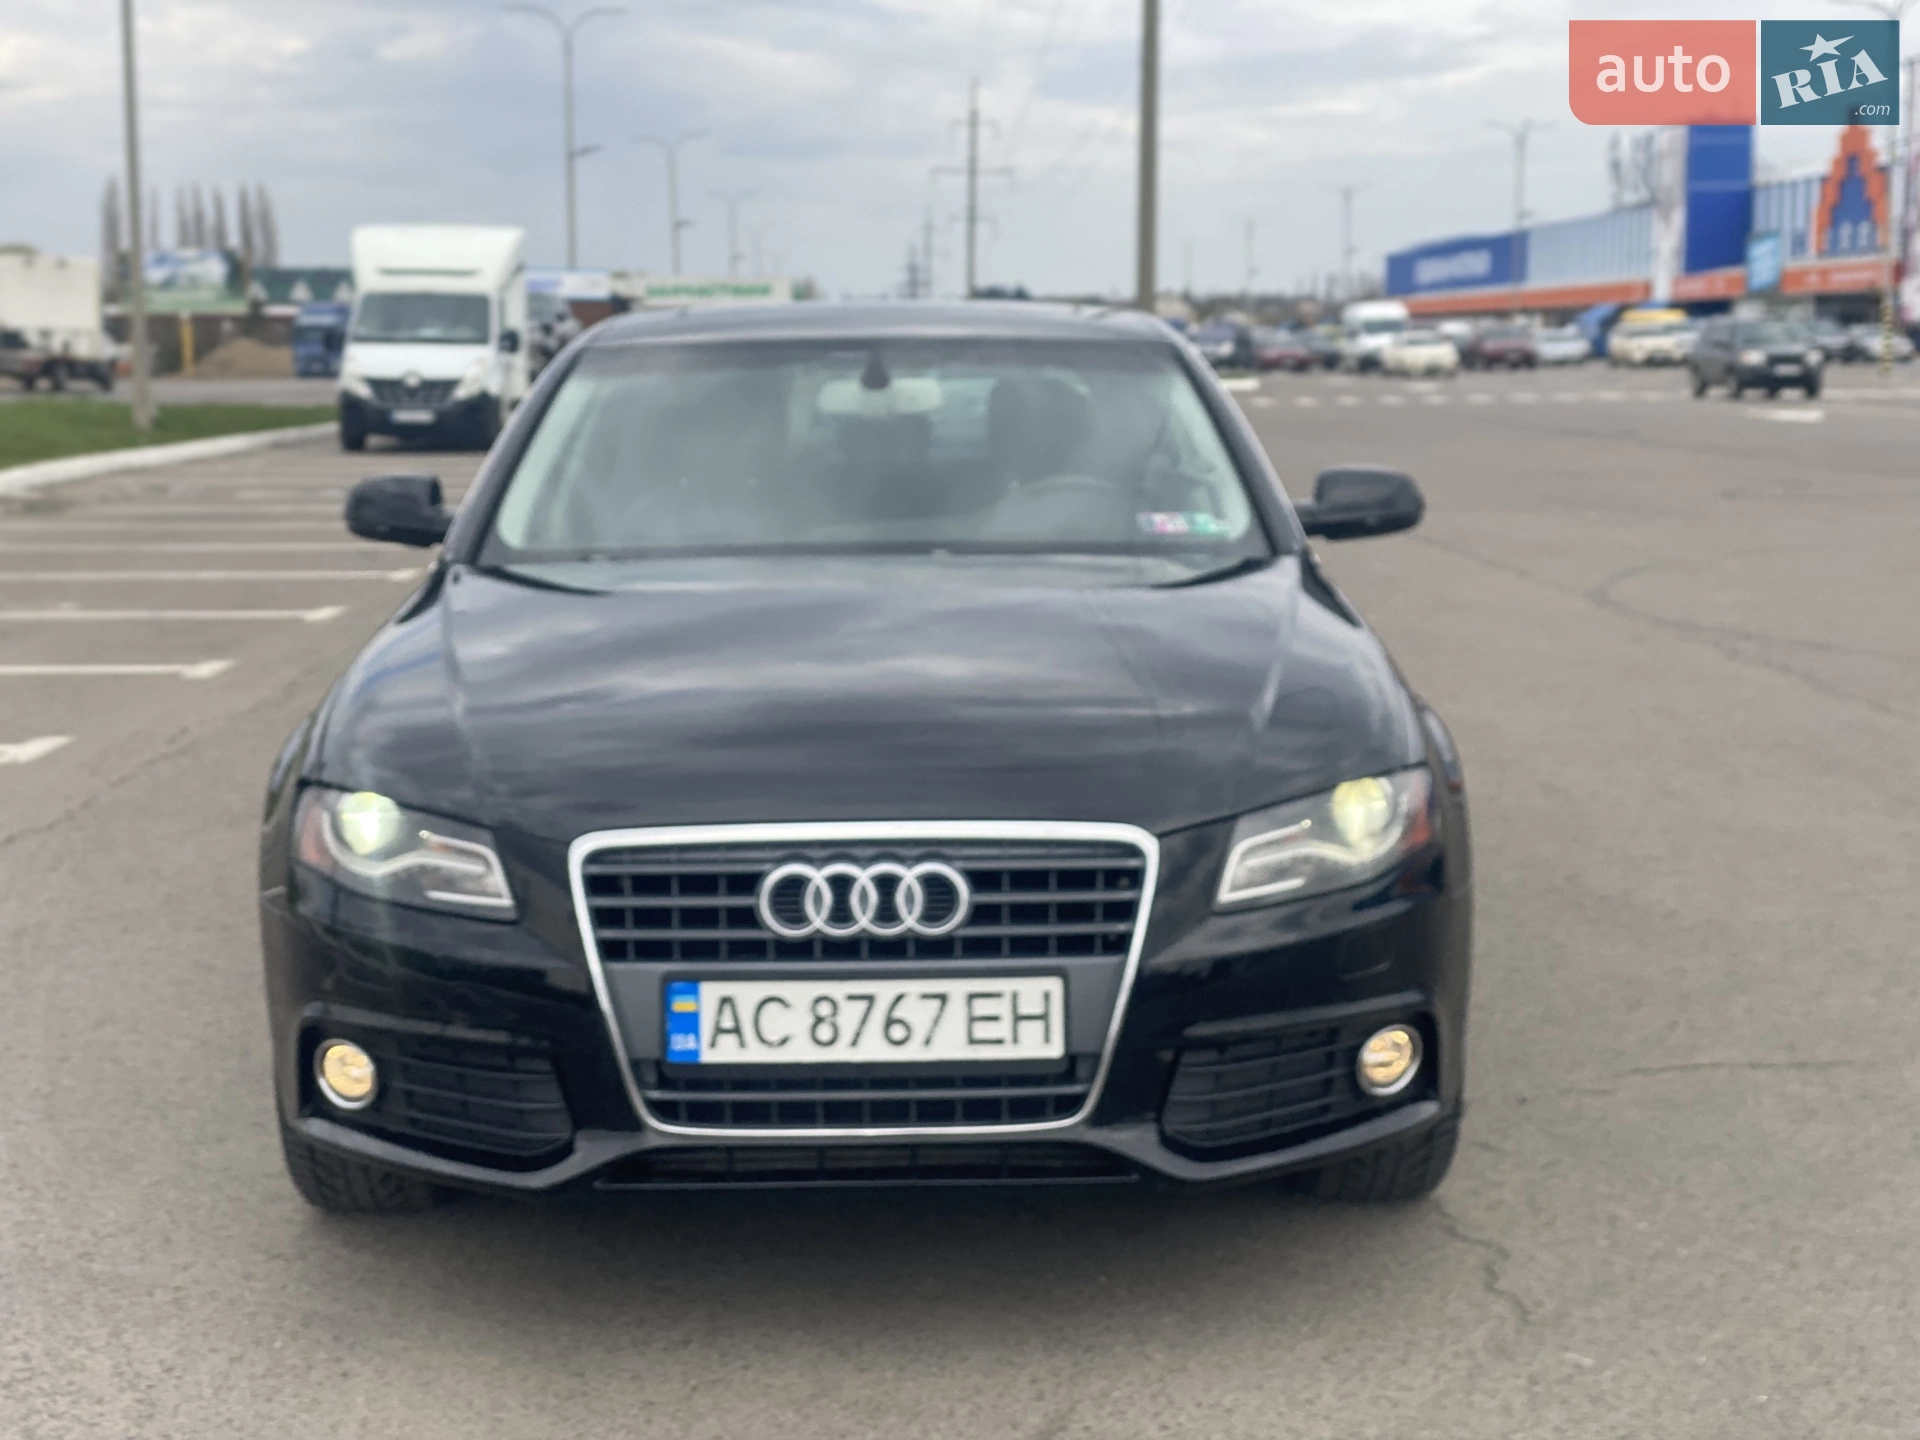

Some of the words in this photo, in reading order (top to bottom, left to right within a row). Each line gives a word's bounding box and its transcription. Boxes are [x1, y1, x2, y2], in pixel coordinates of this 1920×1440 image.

[709, 995, 792, 1049] AC
[810, 992, 948, 1047] 8767
[966, 990, 1052, 1045] EH
